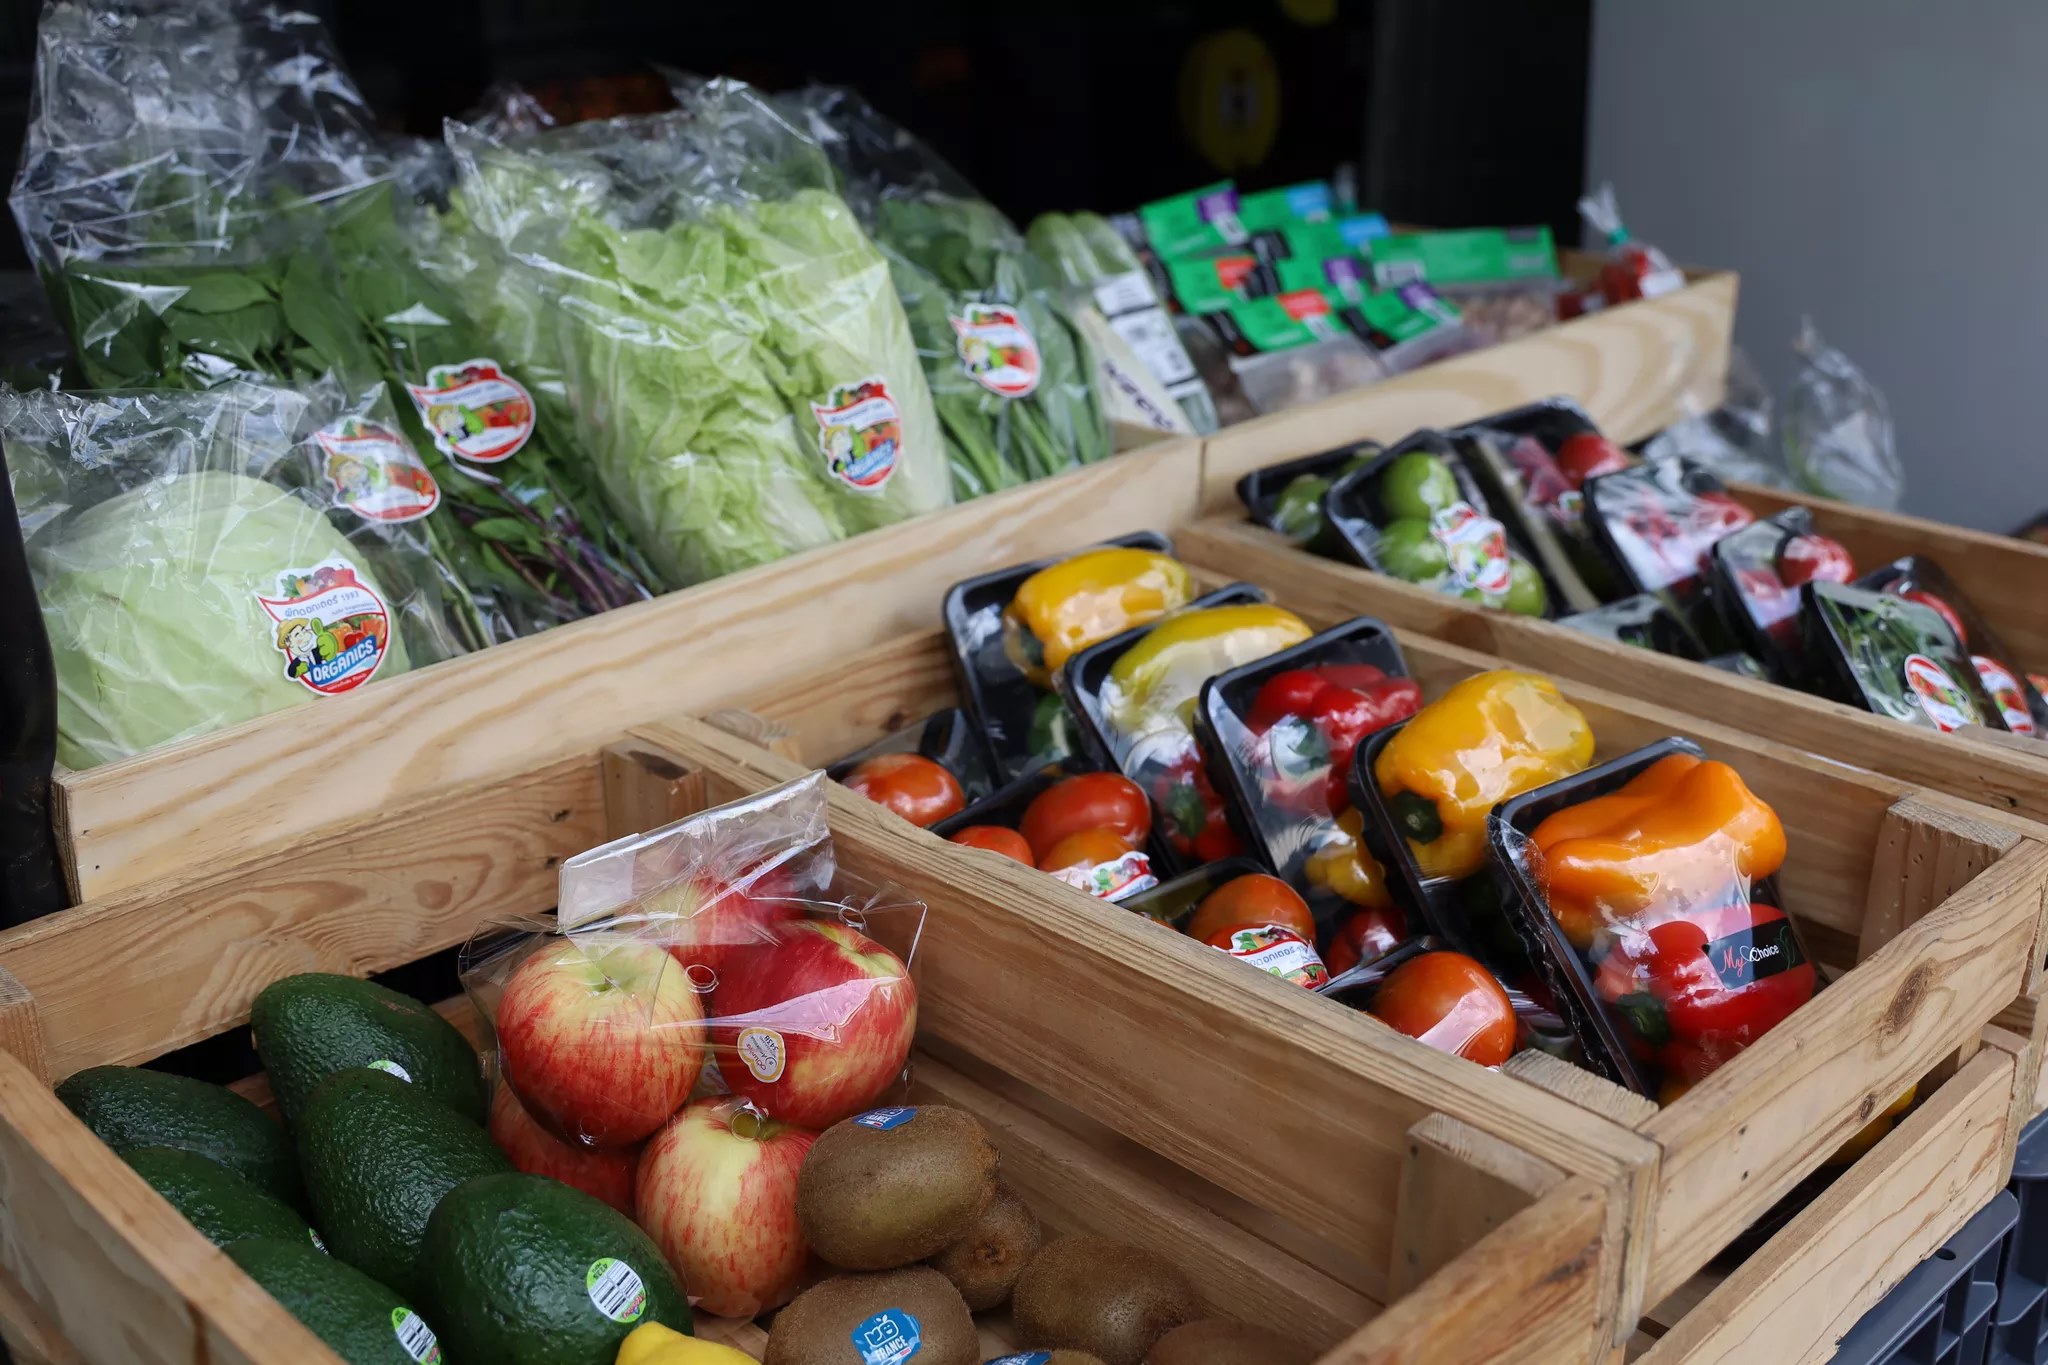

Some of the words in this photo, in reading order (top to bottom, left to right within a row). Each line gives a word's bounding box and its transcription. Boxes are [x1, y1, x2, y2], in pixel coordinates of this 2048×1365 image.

[312, 639, 375, 682] ORGANICS
[1720, 945, 1746, 977] My
[1745, 944, 1780, 962] Choice
[875, 1335, 908, 1361] FRANCE
